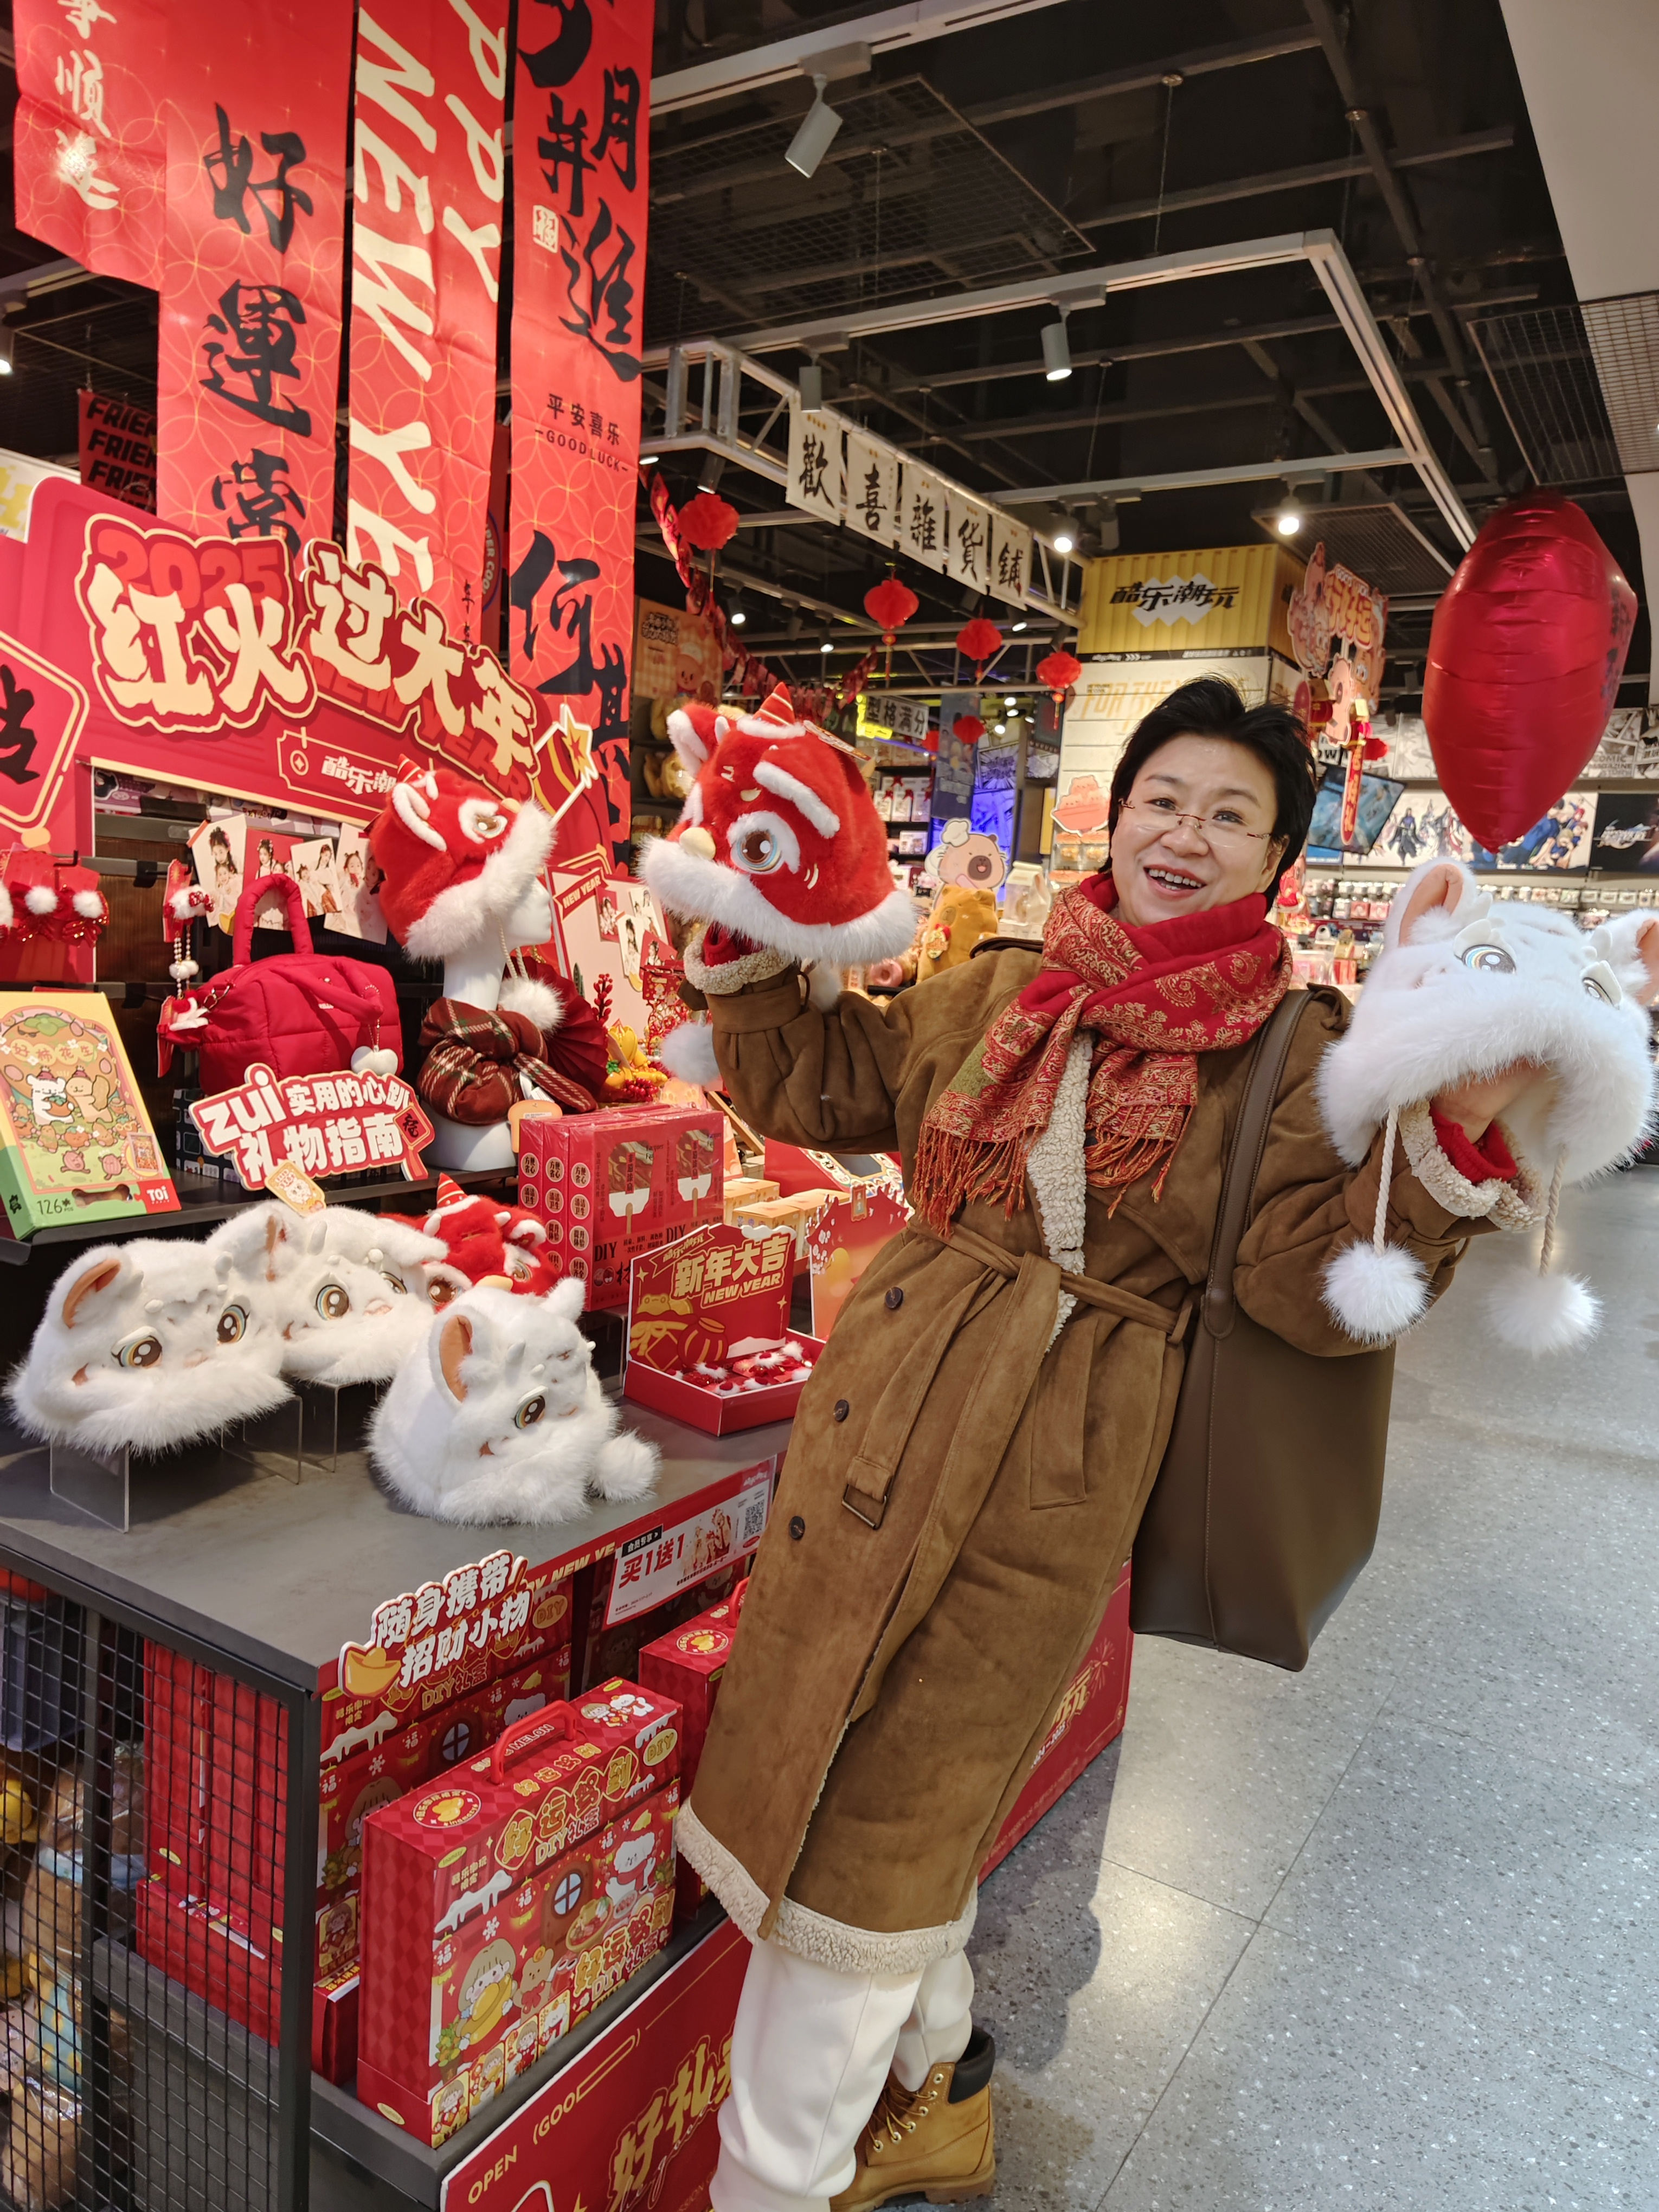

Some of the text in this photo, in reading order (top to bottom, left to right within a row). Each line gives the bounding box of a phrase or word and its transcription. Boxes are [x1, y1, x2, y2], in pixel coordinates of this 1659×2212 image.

[352, 5, 436, 382] NEW
[547, 393, 620, 446] 平安喜乐
[546, 431, 620, 472] GOOD LUCK
[97, 530, 283, 608] 2025
[1110, 581, 1240, 612] 酷乐潮玩
[562, 874, 602, 909] NEW YEAR
[240, 1113, 403, 1183] 礼物指南
[37, 1199, 62, 1215] 126
[594, 1242, 617, 1262] DIY
[673, 1236, 788, 1297] 新年大吉
[704, 1272, 781, 1304] NEW YEAR
[627, 1534, 652, 1553] 会员专享
[551, 1554, 590, 1583] NEW
[619, 1533, 685, 1589] 买1送1
[377, 1554, 511, 1649] 随身携带
[536, 1598, 564, 1625] DIY
[400, 1589, 531, 1688] 招财小物
[491, 1687, 503, 1704] 福
[404, 1731, 419, 1750] 福
[510, 1724, 555, 1751] MELON
[647, 1732, 675, 1763] DIY
[322, 1774, 337, 1794] 福
[536, 1806, 600, 1866] DIY礼盒
[601, 1830, 613, 1850] 福
[518, 1887, 532, 1908] 福
[436, 1943, 452, 1966] 福
[467, 2145, 517, 2204] OPEN
